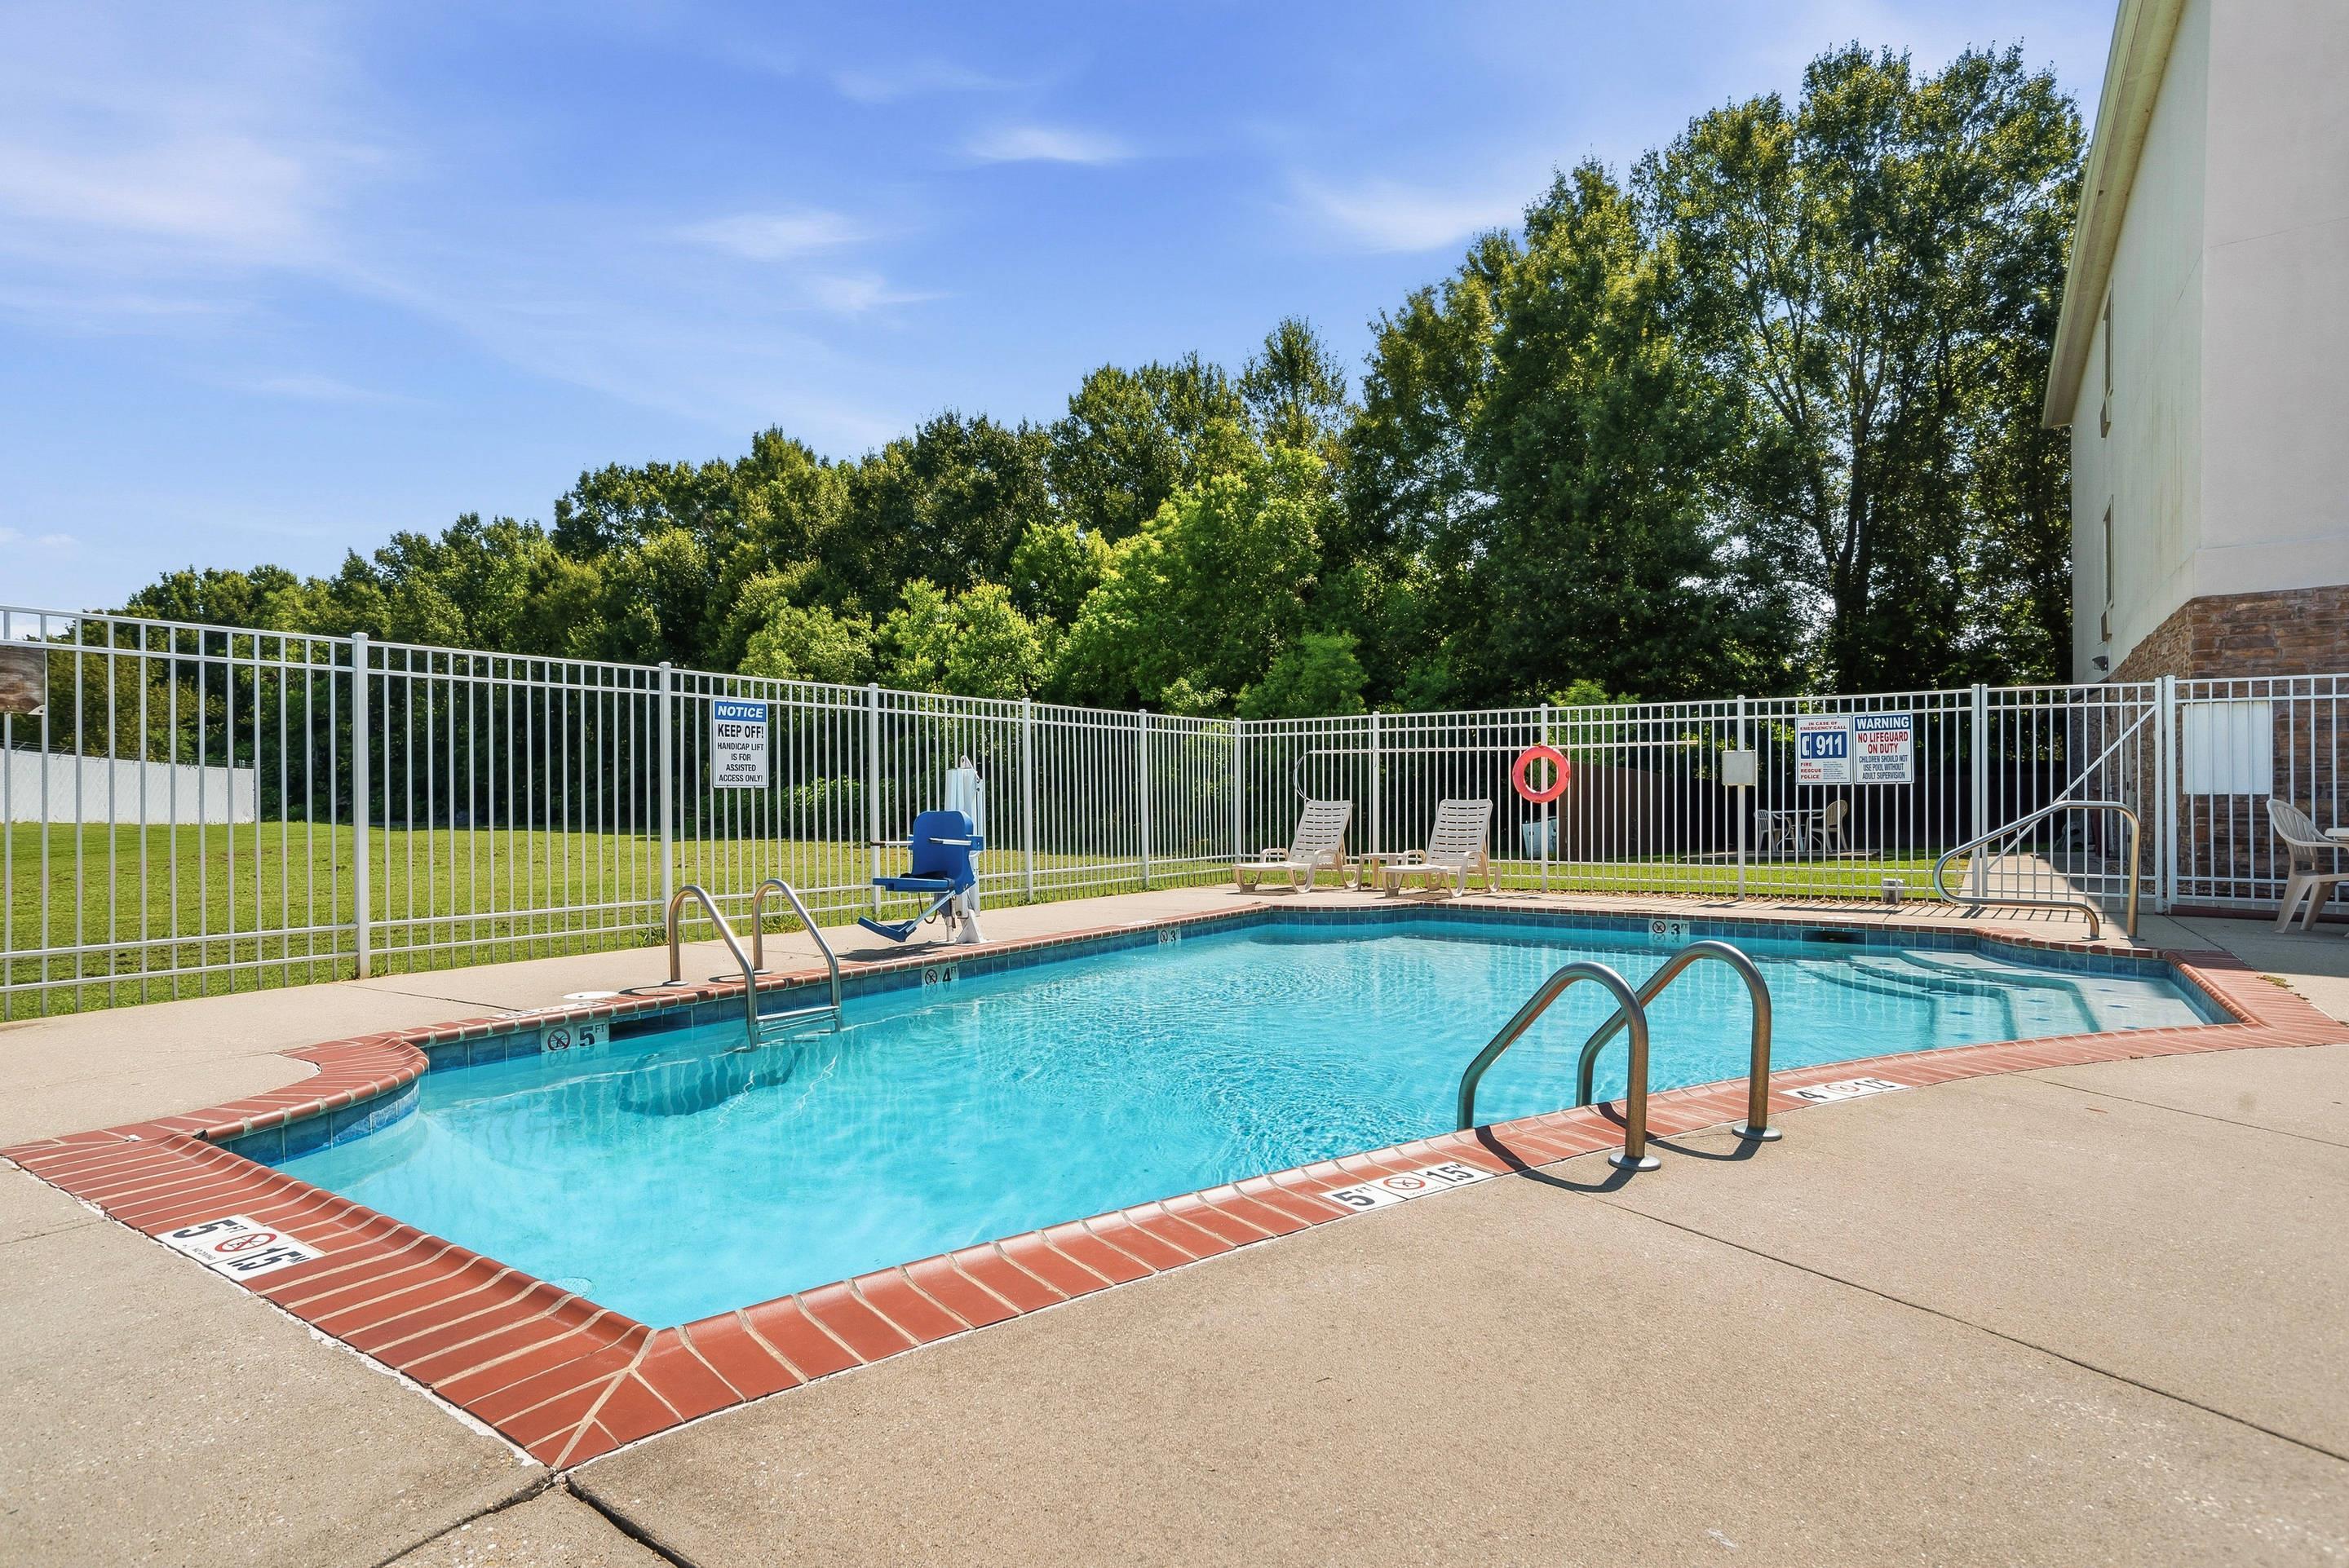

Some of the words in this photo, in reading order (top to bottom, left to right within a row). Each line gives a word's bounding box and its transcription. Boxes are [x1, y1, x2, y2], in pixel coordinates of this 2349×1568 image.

[718, 705, 764, 718] NOTICE
[1856, 717, 1909, 730] WARNING
[718, 723, 741, 737] KEEP
[745, 725, 763, 739] OFF!
[1858, 732, 1868, 743] NO
[1869, 731, 1909, 743] LIFEGUARD
[718, 742, 750, 750] HANDICAP
[1816, 734, 1842, 756] 911
[1868, 744, 1878, 754] ON
[1879, 743, 1899, 753] DUTY
[731, 753, 737, 761] IS
[1859, 755, 1880, 763] CHILDREN
[1899, 754, 1908, 762] NOT
[1873, 763, 1884, 771] POOL
[719, 774, 744, 782] ACCESS
[1877, 771, 1905, 780] SUPERVISION
[1670, 923, 1680, 935] 3
[942, 967, 952, 982] 4
[579, 1025, 595, 1047] 5
[595, 1023, 606, 1033] FT
[1796, 1090, 1829, 1099] 4
[1426, 1167, 1475, 1182] 1.5
[1332, 1190, 1376, 1207] 5
[172, 1219, 239, 1239] 5
